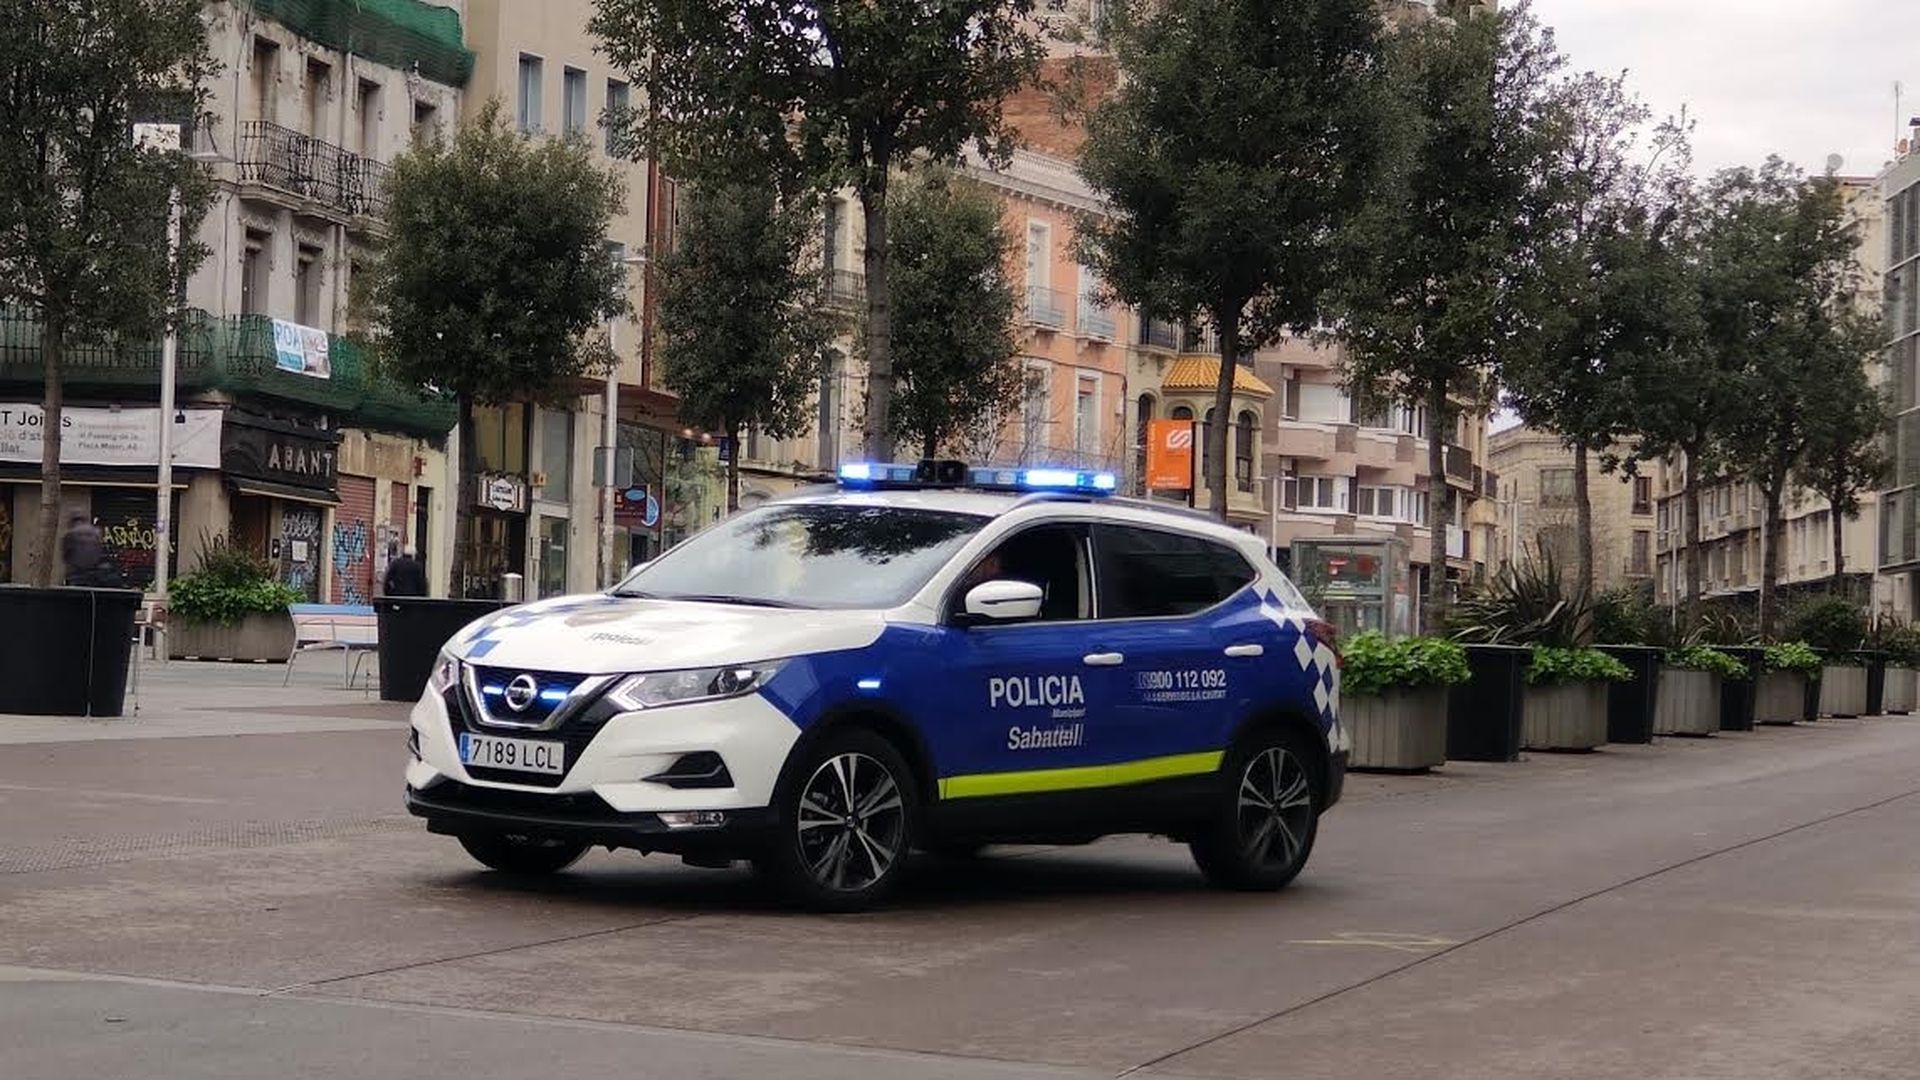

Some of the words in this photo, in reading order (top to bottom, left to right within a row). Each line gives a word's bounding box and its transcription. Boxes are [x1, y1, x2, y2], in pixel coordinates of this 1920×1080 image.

[17, 411, 72, 428] Jois
[268, 443, 333, 478] ABANT
[989, 675, 1085, 708] POLICIA
[1175, 671, 1199, 688] 112
[1201, 669, 1227, 688] 092
[473, 738, 516, 765] 7189
[523, 744, 558, 769] LCL
